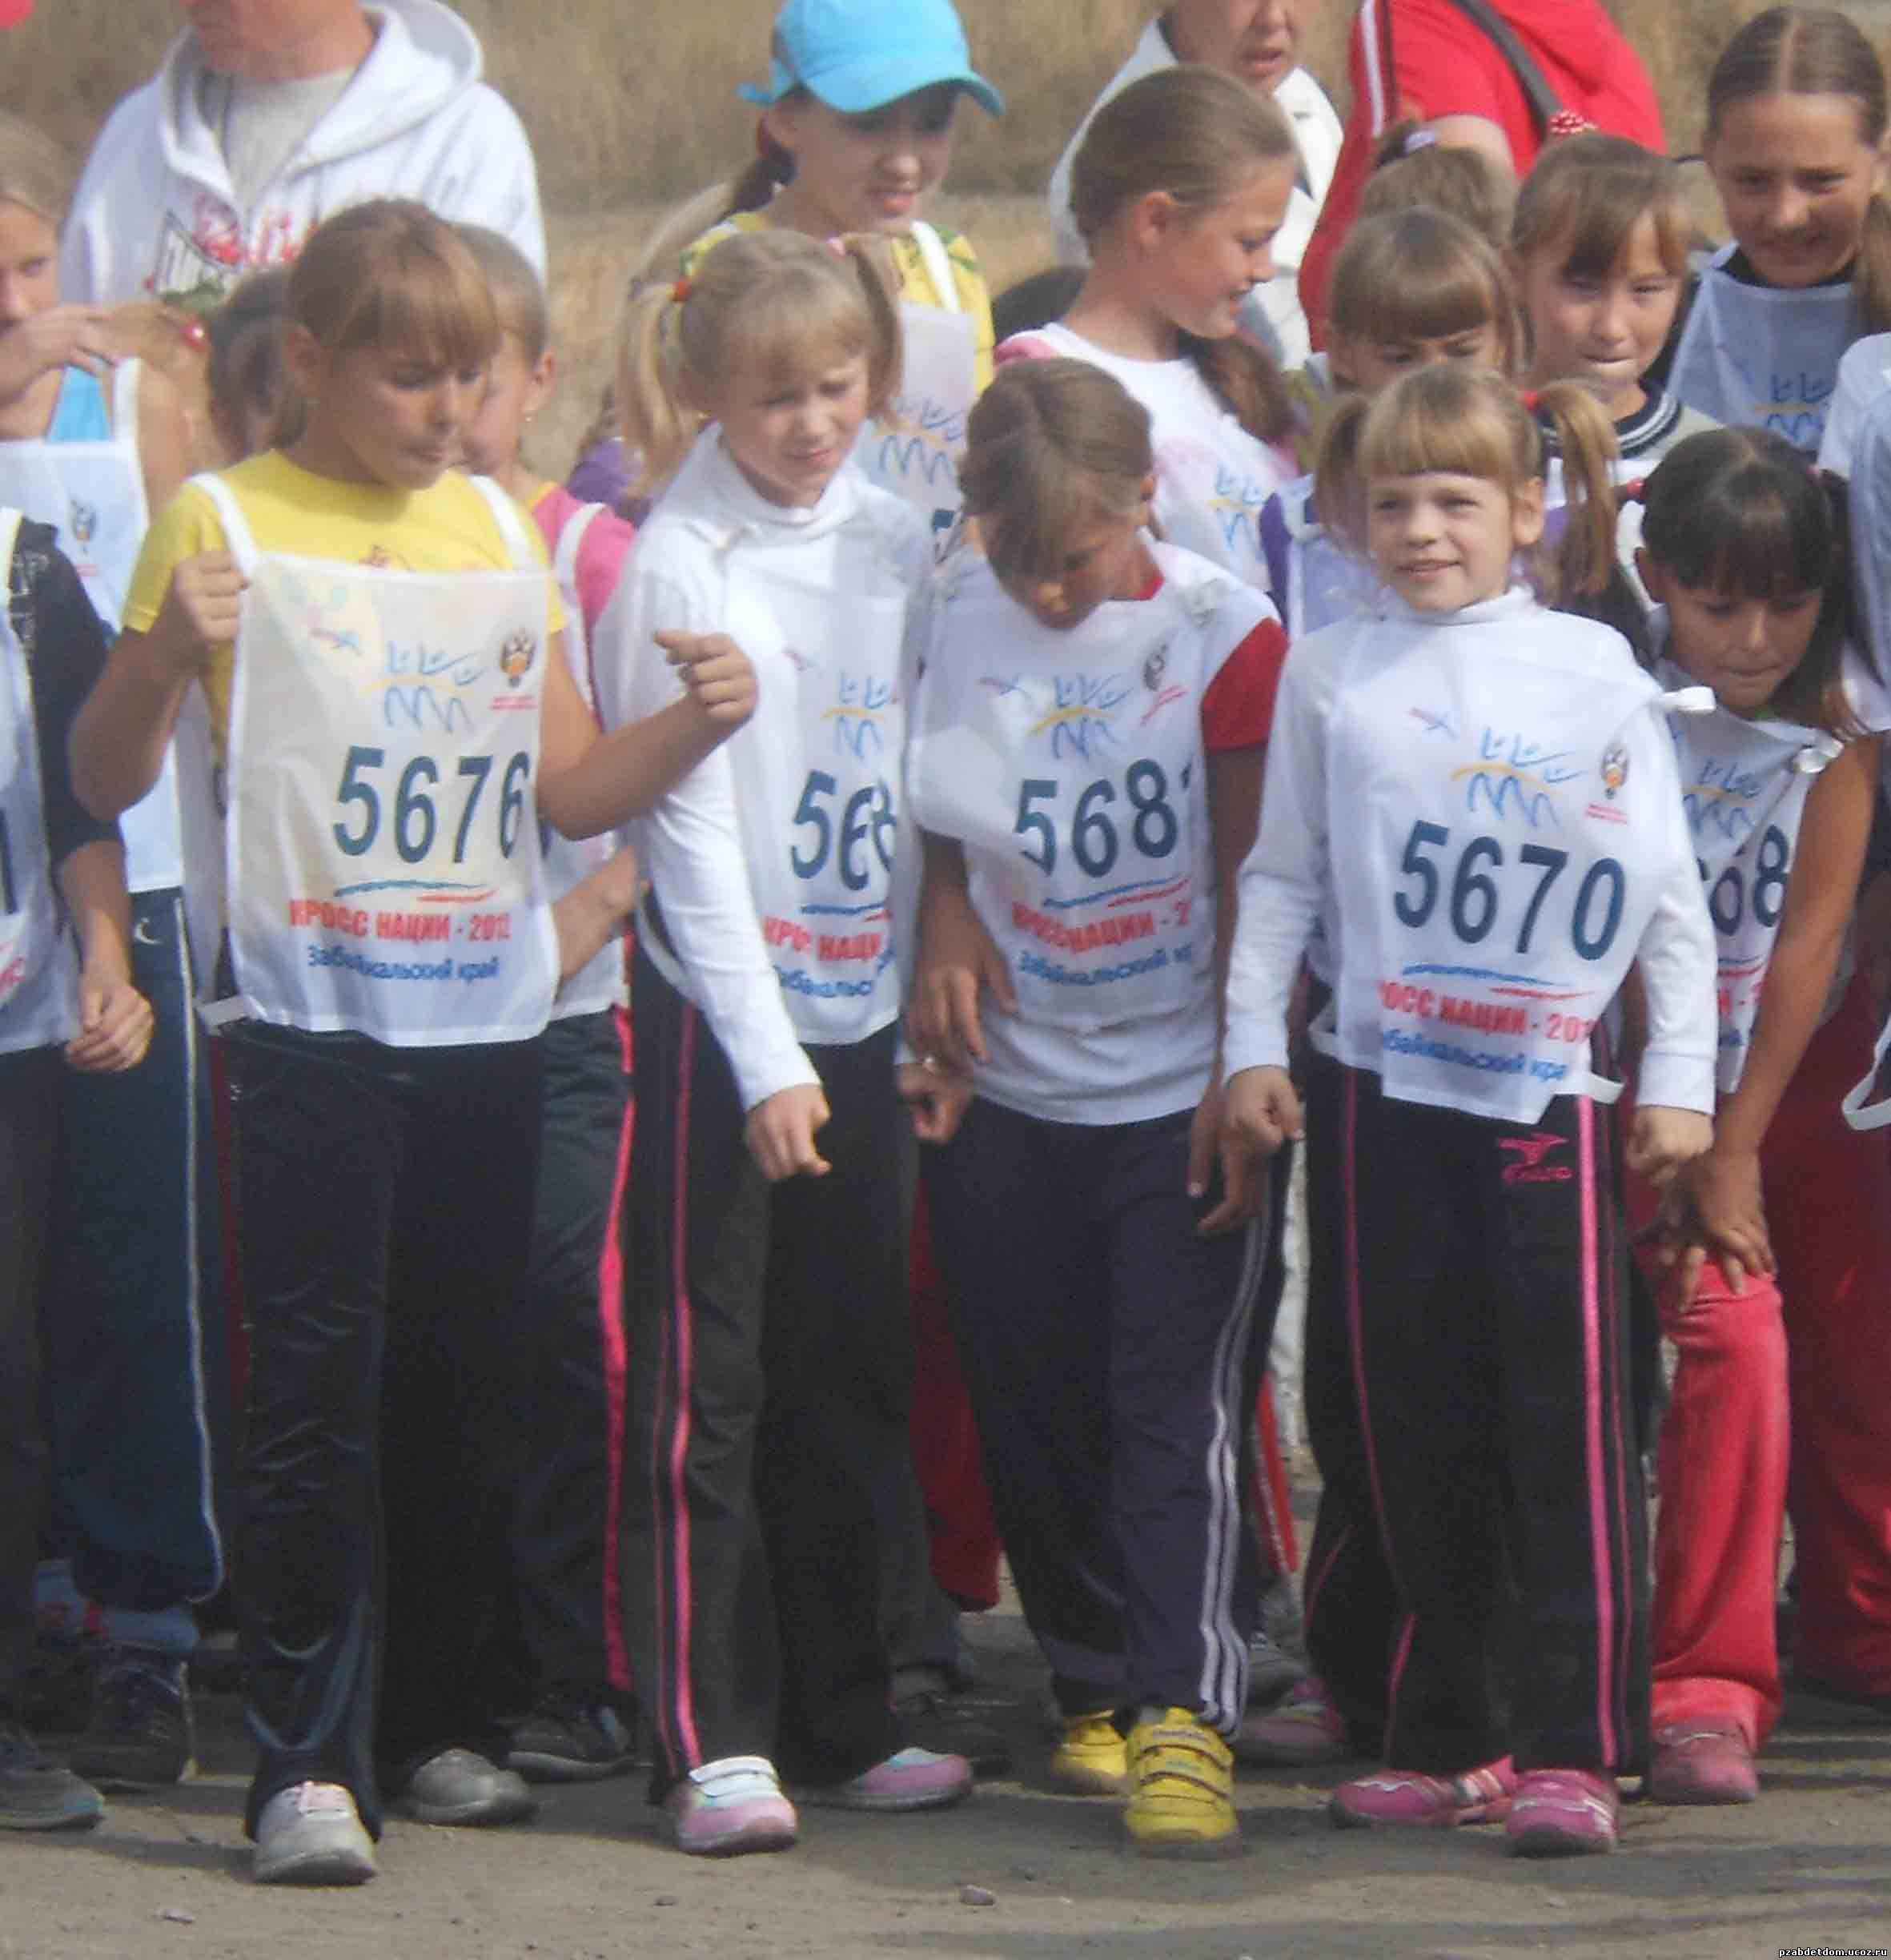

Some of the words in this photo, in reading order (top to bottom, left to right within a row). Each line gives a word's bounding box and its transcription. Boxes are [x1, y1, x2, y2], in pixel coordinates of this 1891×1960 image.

[332, 745, 529, 863] 5676
[1014, 759, 1191, 877] 568
[1394, 820, 1625, 961] 5670
